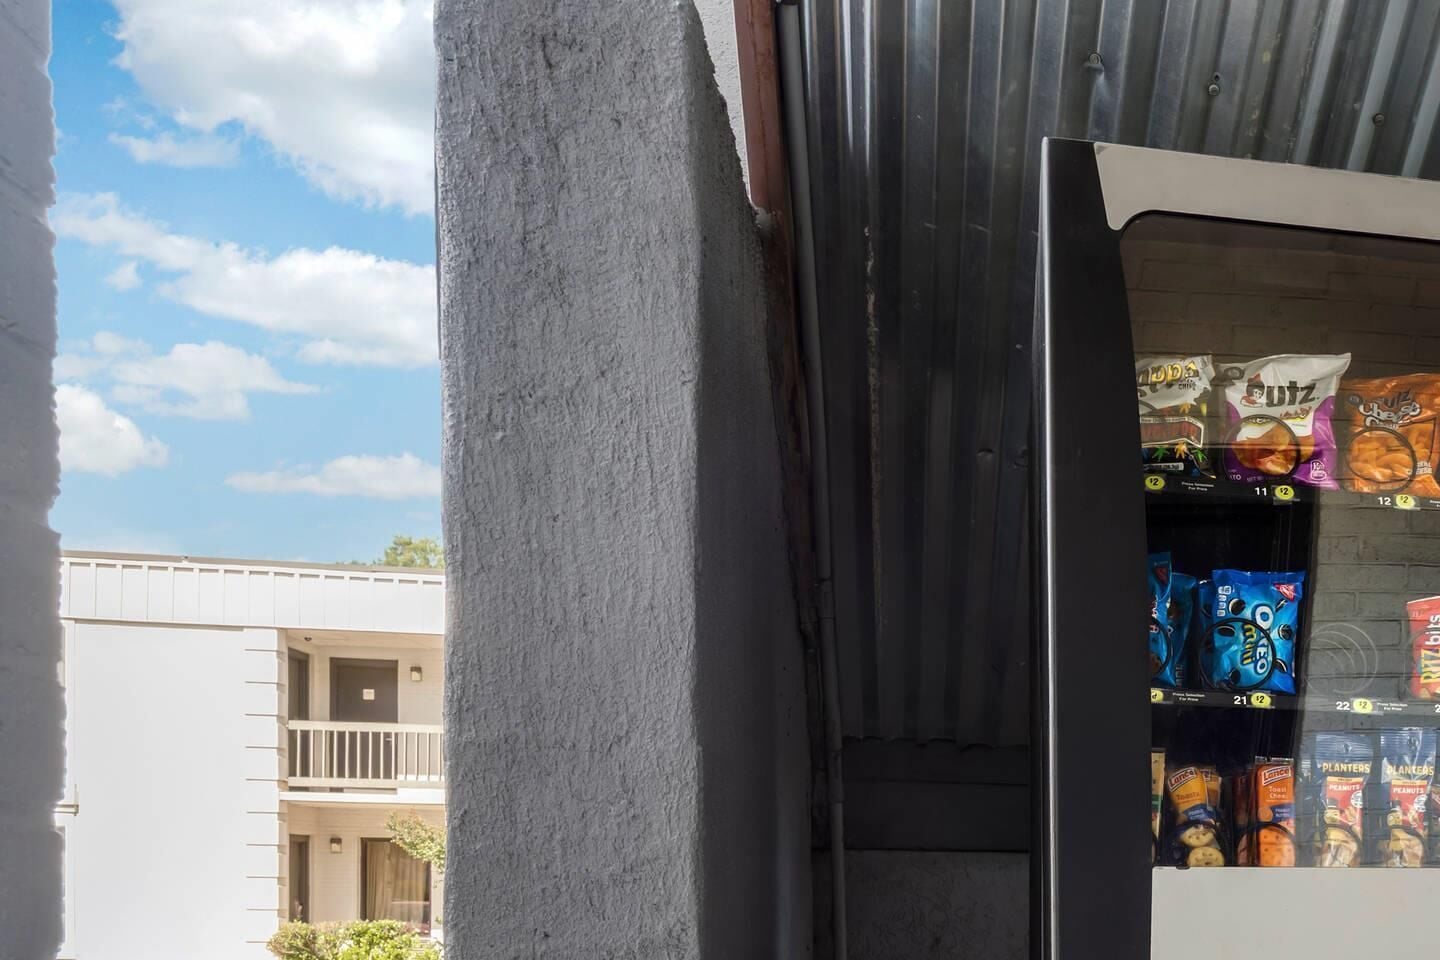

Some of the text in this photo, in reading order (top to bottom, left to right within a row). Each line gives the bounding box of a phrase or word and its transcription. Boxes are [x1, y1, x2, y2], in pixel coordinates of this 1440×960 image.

[1149, 478, 1158, 486] $2
[1254, 487, 1267, 496] 11
[1280, 487, 1289, 495] $2
[1378, 497, 1391, 505] 12
[1234, 695, 1247, 705] 21
[1256, 695, 1265, 703] $2
[1336, 701, 1350, 710] 22
[1359, 701, 1368, 709] $2
[1322, 762, 1371, 774] PLANTERS
[1168, 768, 1196, 788] Lance
[1263, 767, 1289, 781] Lance
[1329, 783, 1360, 791] PEANUTS
[1392, 787, 1425, 795] PEANUTS
